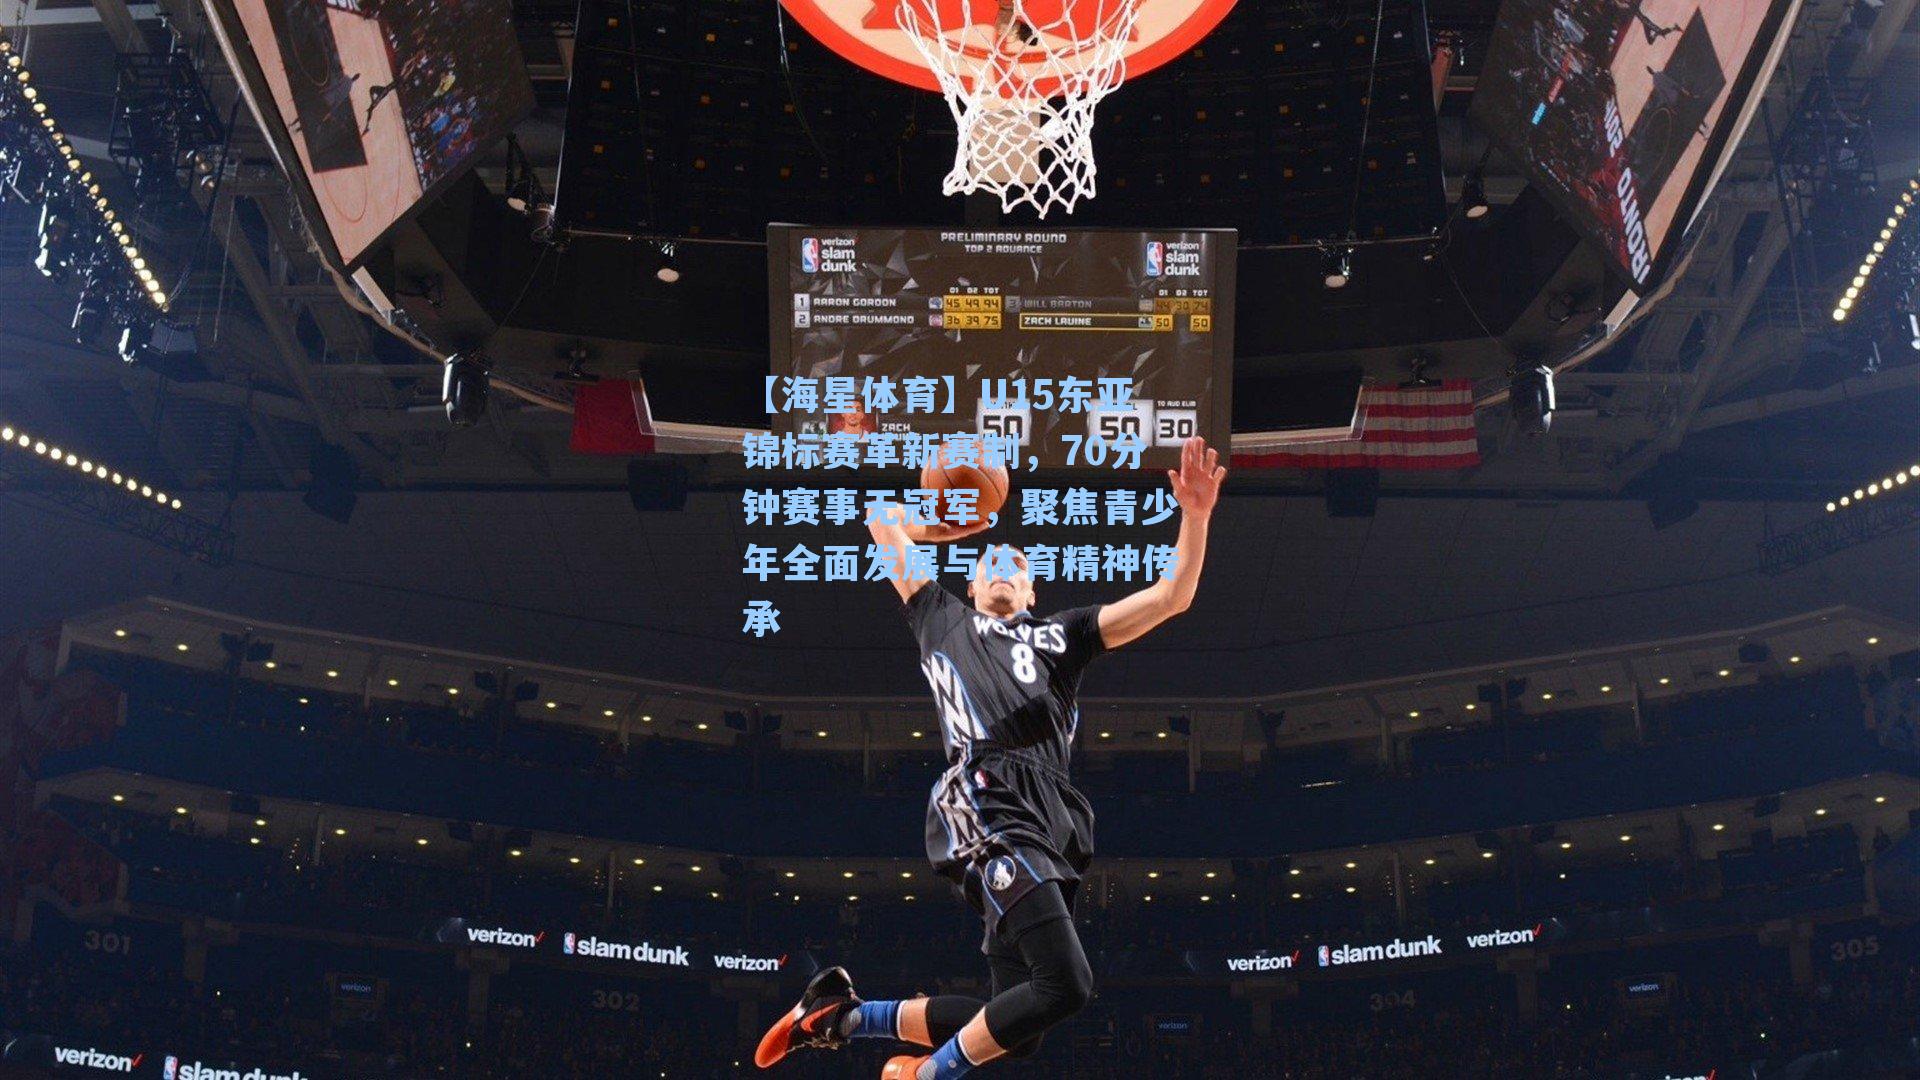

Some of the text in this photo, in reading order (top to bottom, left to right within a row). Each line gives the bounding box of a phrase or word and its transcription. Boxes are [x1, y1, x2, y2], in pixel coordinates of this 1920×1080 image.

[821, 238, 855, 246] verizon
[941, 232, 1067, 243] PRELIMINARY ROUND
[965, 244, 984, 253] TOP
[986, 245, 993, 253] 2
[1166, 242, 1200, 250] verizon
[821, 247, 856, 259] slam
[1165, 251, 1200, 263] slam
[821, 259, 857, 272] dunk
[1165, 263, 1200, 276] dunk
[1192, 289, 1208, 297] TOT
[814, 298, 850, 307] AARON
[853, 298, 897, 307] GORDON
[946, 299, 960, 308] 45
[965, 299, 979, 308] 49
[984, 299, 999, 308] 94
[1024, 299, 1047, 308] WILL
[1050, 300, 1092, 309] BARTON
[813, 315, 850, 324] ANDRE
[853, 315, 915, 324] DRUMMOND
[965, 316, 980, 325] 39
[983, 316, 999, 325] 75
[1024, 316, 1052, 326] ZACH
[1156, 318, 1170, 327] 50
[1193, 318, 1208, 327] 50
[882, 422, 911, 432] ZACH
[1160, 418, 1193, 438] 30
[973, 616, 1067, 653] WOLVES
[1011, 643, 1037, 684] 8
[467, 927, 536, 947] verizon
[1466, 929, 1534, 948] verizon
[577, 936, 690, 966] slam dunk
[1331, 935, 1443, 965] slam dunk
[714, 954, 779, 971] verizon
[1227, 955, 1292, 972] verizon
[340, 982, 372, 993] verizon
[1629, 982, 1660, 992] verizon
[54, 1046, 132, 1072] verizon
